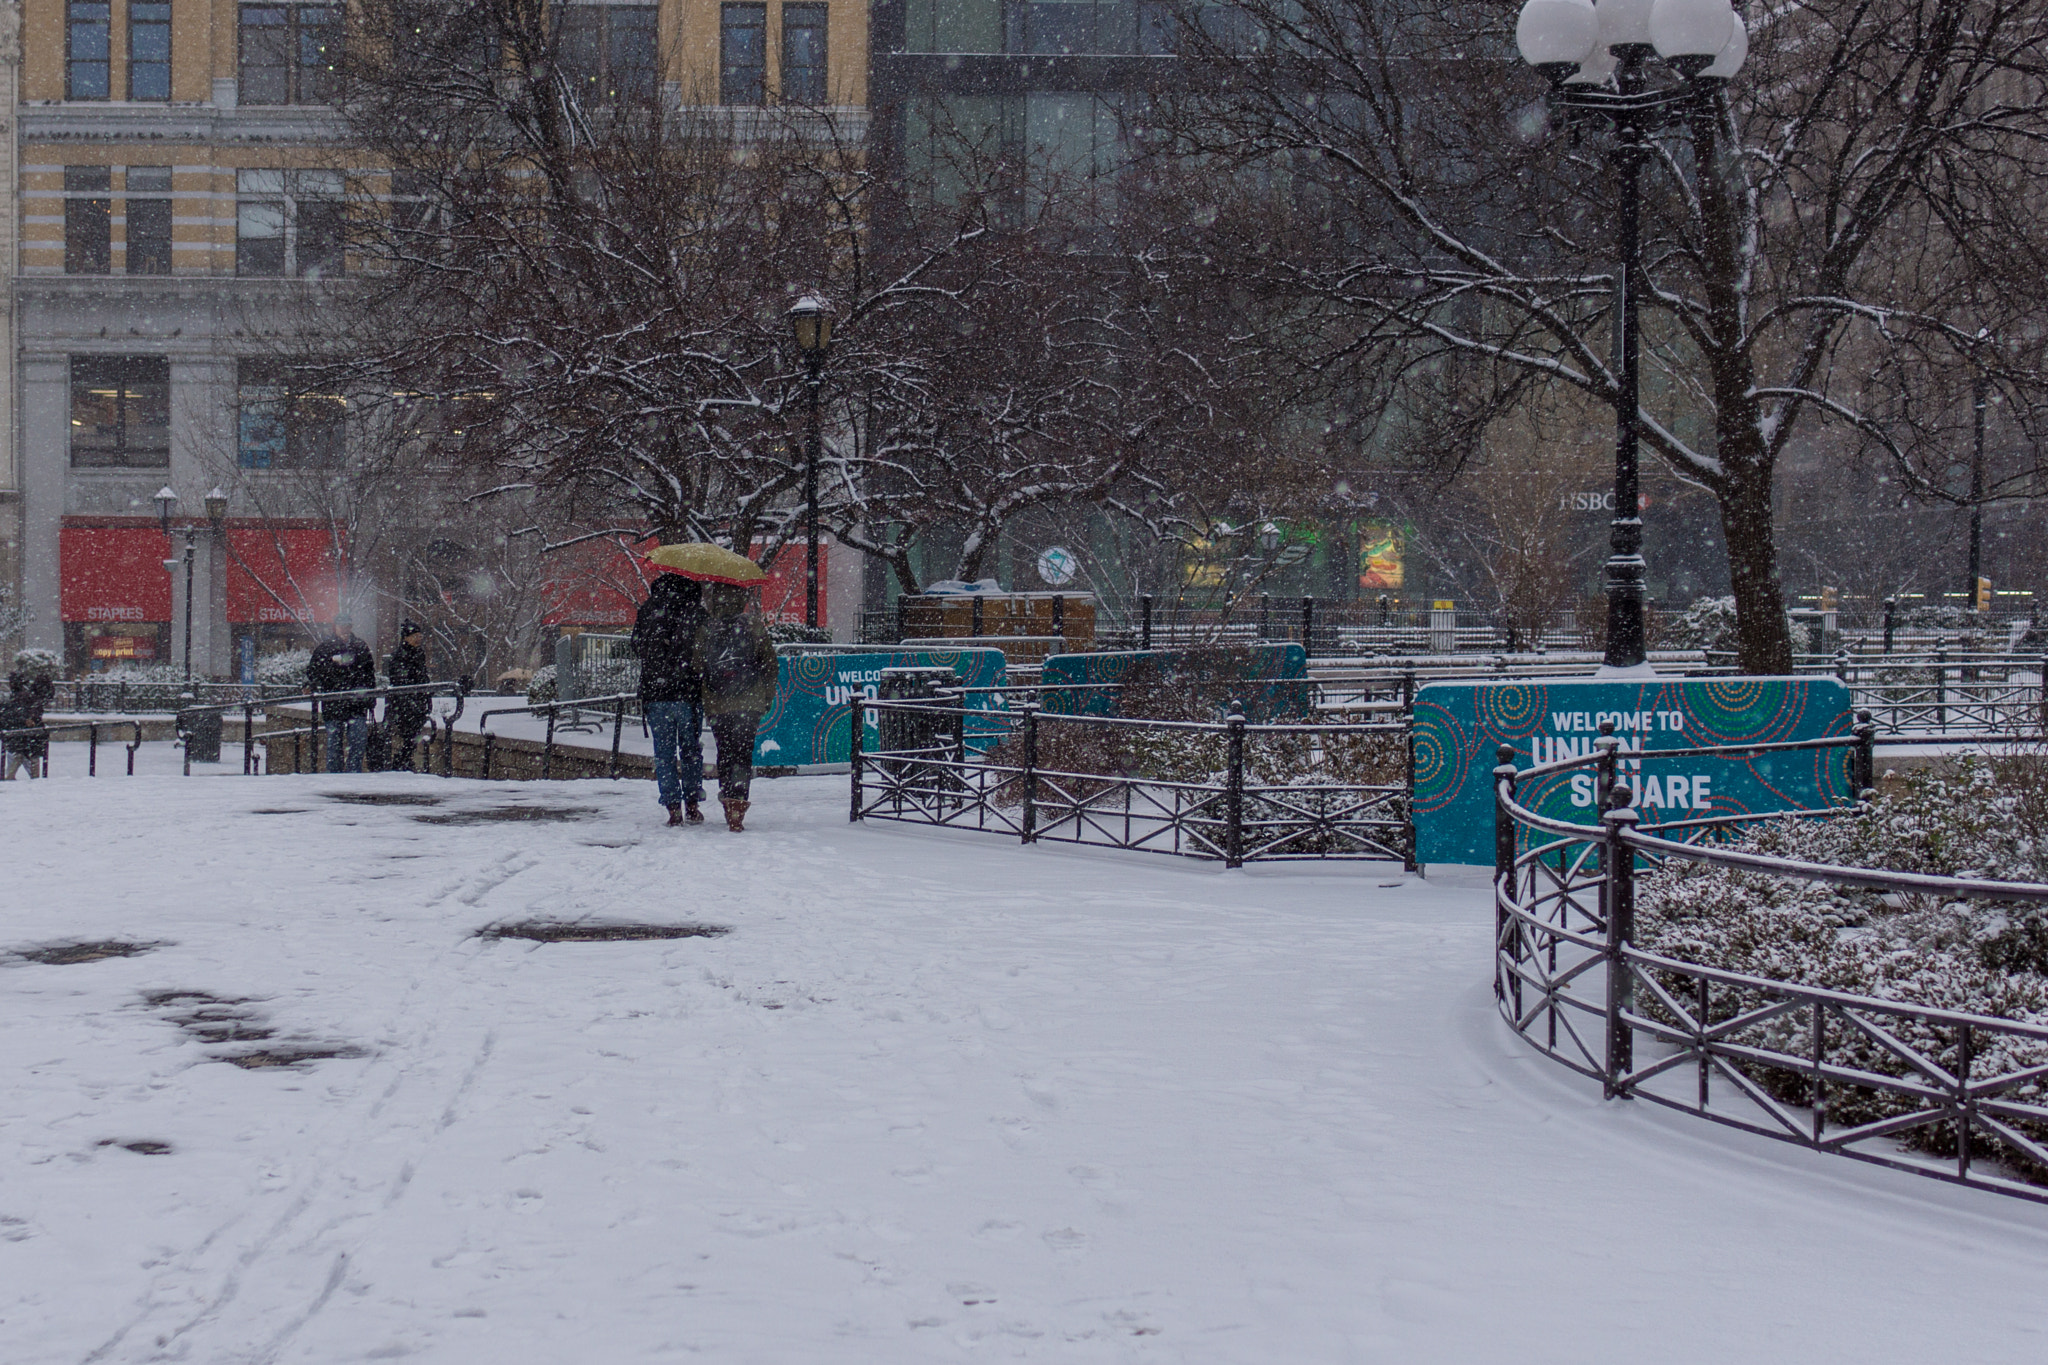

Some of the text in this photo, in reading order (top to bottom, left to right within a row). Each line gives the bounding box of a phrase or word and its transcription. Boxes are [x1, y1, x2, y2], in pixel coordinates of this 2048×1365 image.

[1559, 492, 1616, 511] HSBC
[87, 606, 144, 620] STAPLES
[259, 607, 315, 621] STAPLES
[837, 669, 880, 683] WELCO
[1551, 710, 1684, 732] WELCOME TO
[1531, 736, 1641, 770] UNIN
[1570, 773, 1713, 809] SUARE
